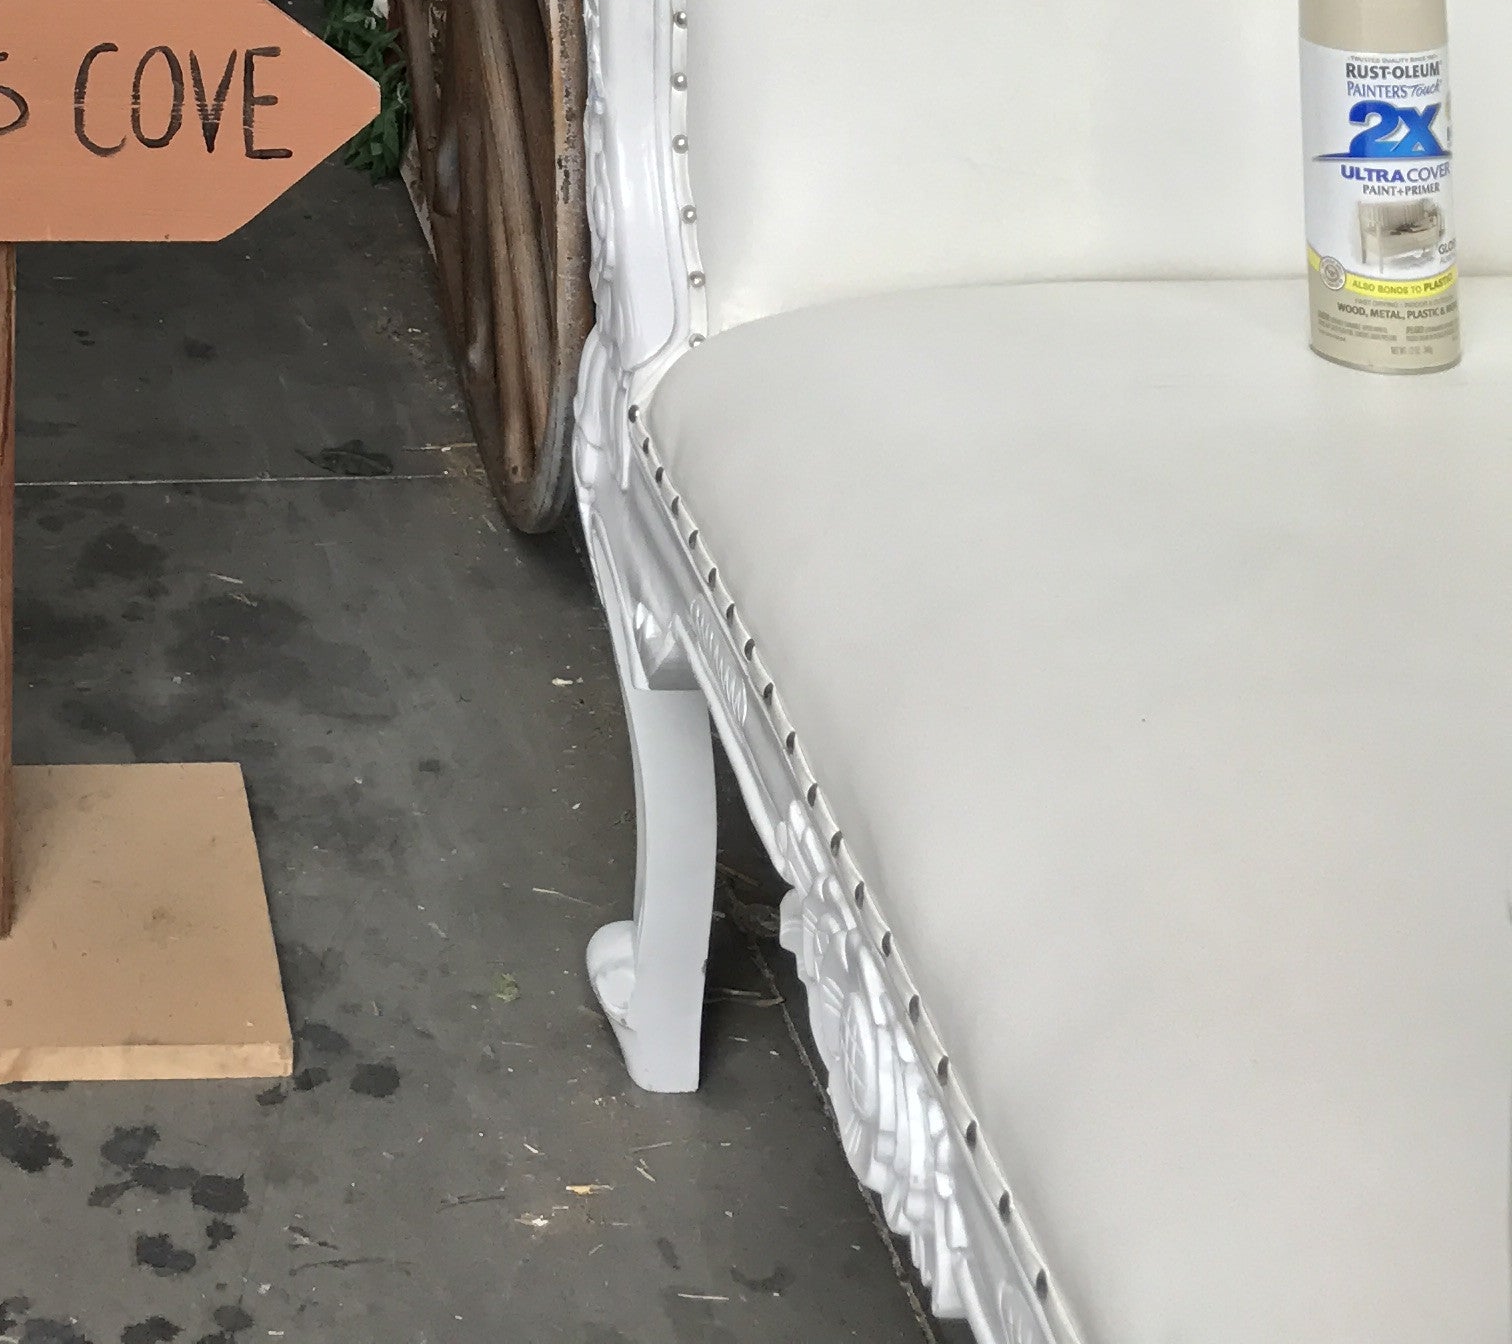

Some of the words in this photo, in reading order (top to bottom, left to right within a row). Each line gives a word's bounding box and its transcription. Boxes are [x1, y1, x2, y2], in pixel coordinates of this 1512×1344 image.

[1345, 60, 1440, 80] RUST-OLEUM
[74, 42, 294, 160] COVE
[1349, 99, 1442, 158] 2X
[1340, 164, 1406, 183] ULTRA
[1406, 161, 1450, 182] COVER
[1351, 279, 1376, 292] ALSO
[1377, 284, 1409, 295] BONDS
[1411, 285, 1422, 294] TO
[1369, 309, 1406, 321] METAL,
[1407, 307, 1439, 320] PLASTIC
